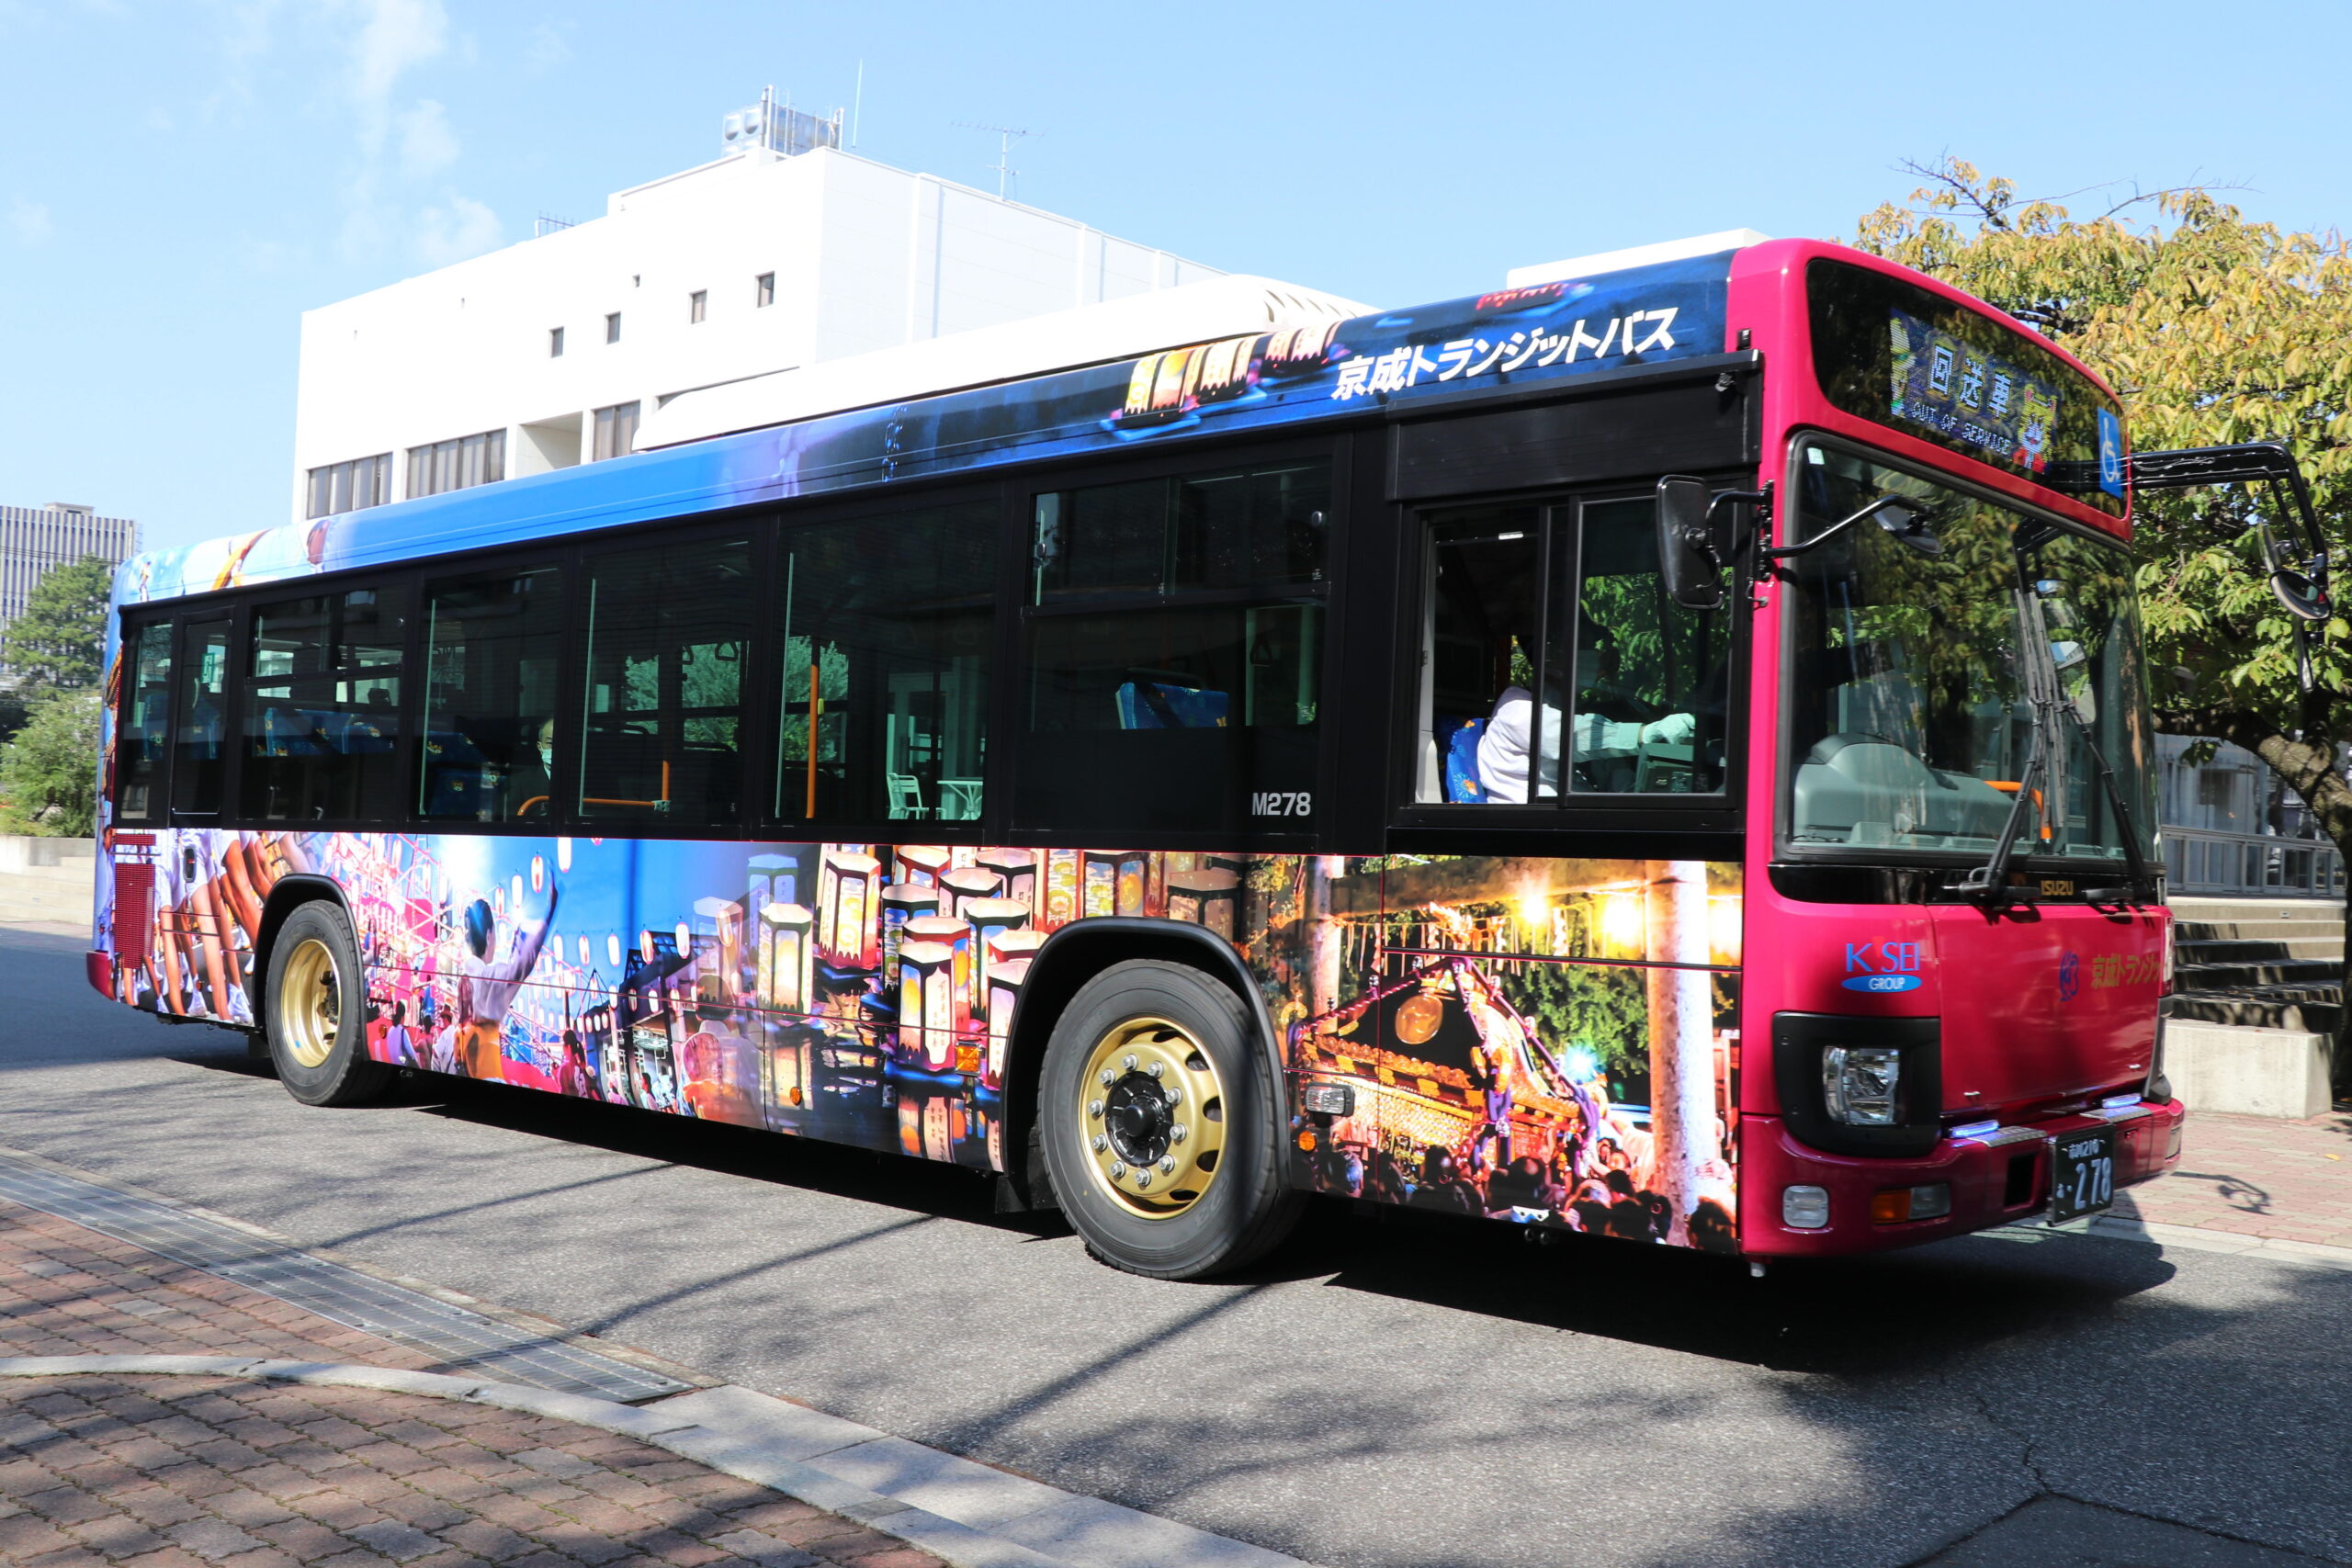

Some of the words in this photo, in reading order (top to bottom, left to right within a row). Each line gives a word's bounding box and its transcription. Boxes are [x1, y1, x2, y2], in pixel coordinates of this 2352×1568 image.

[1331, 307, 1679, 400] 京成トランジットバス
[1929, 344, 2012, 418] 回送車
[1911, 401, 1937, 424] OUT
[1940, 413, 1958, 432] OF
[1962, 423, 2012, 456] SERVICE
[1252, 792, 1311, 817] M278
[2041, 880, 2074, 896] ISUZU
[1868, 976, 1905, 990] GROUP
[2075, 1156, 2112, 1210] 278
